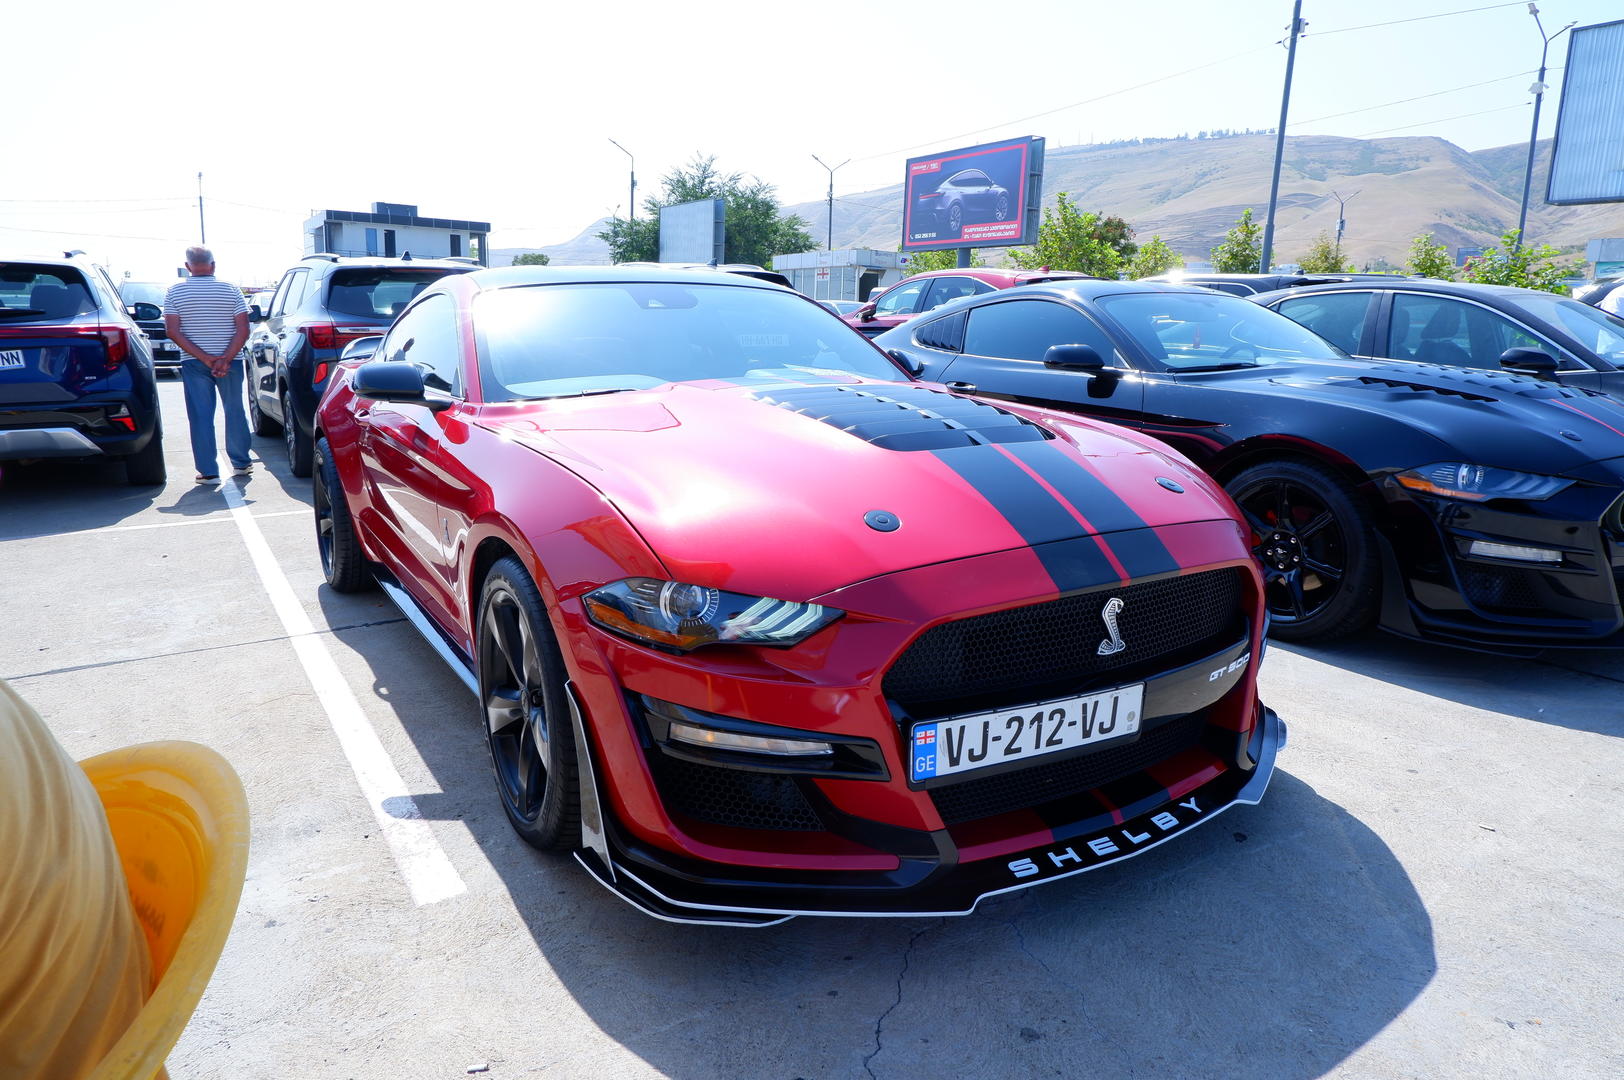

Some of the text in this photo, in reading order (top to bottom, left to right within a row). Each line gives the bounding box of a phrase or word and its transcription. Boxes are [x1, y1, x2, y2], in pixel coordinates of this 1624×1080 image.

[1209, 652, 1250, 681] GT 500
[945, 695, 1119, 768] VJ-212-VJ
[915, 754, 935, 773] GE
[1007, 797, 1202, 878] SHELBY
